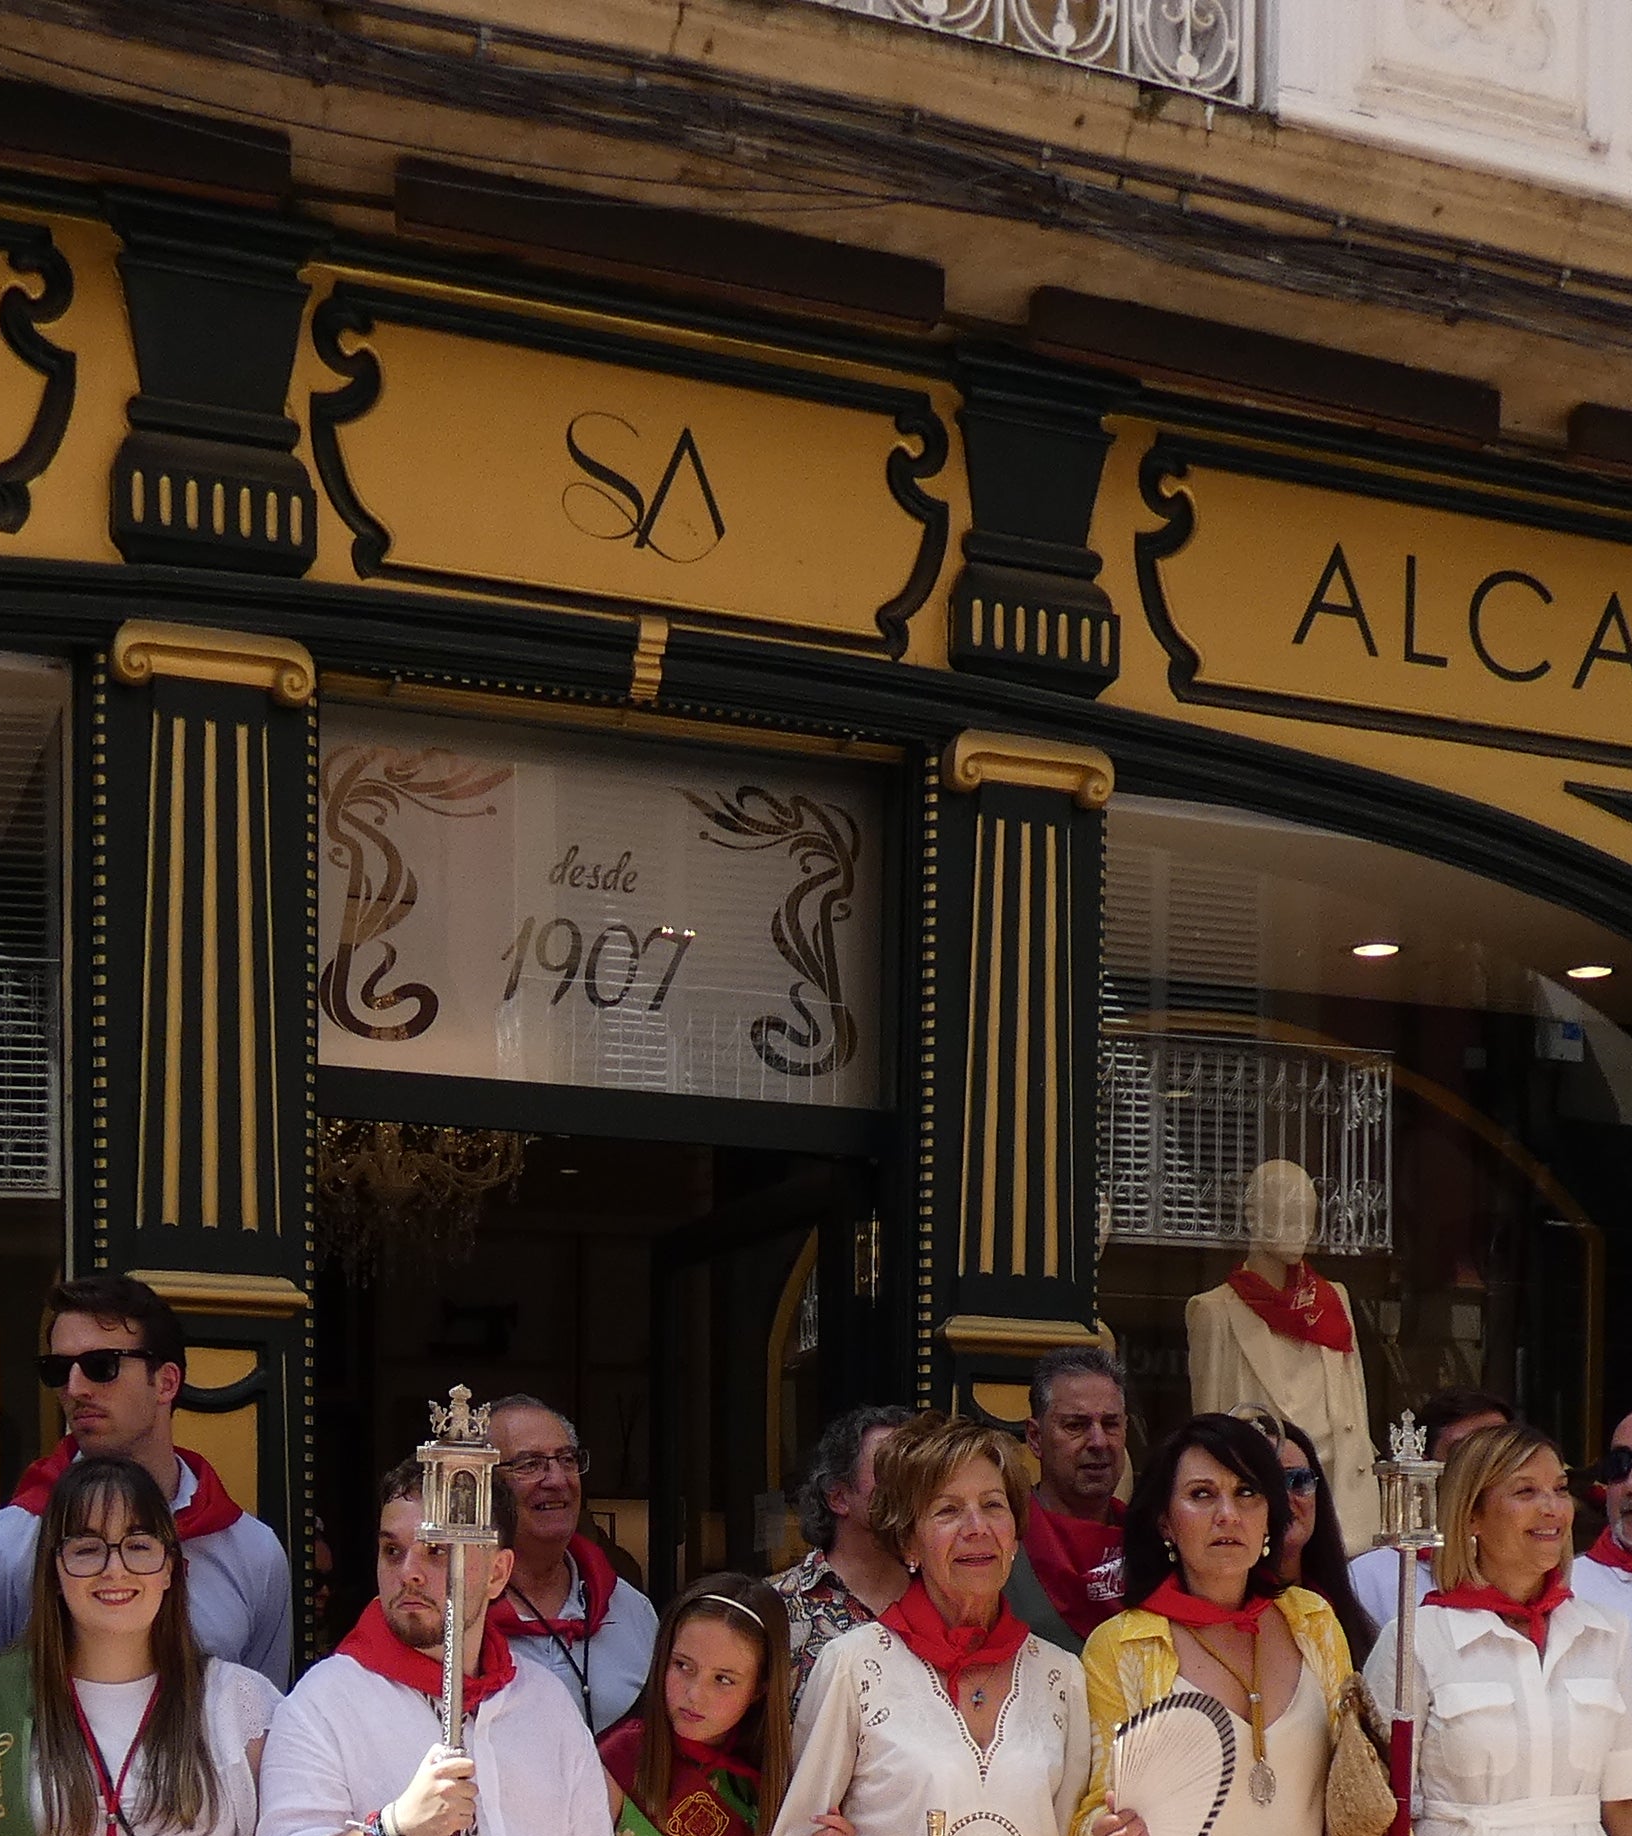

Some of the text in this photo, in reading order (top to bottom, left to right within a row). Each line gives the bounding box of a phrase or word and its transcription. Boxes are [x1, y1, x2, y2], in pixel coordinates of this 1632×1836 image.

[561, 410, 727, 564] SA
[548, 846, 638, 894] desde
[501, 916, 696, 1011] 1907
